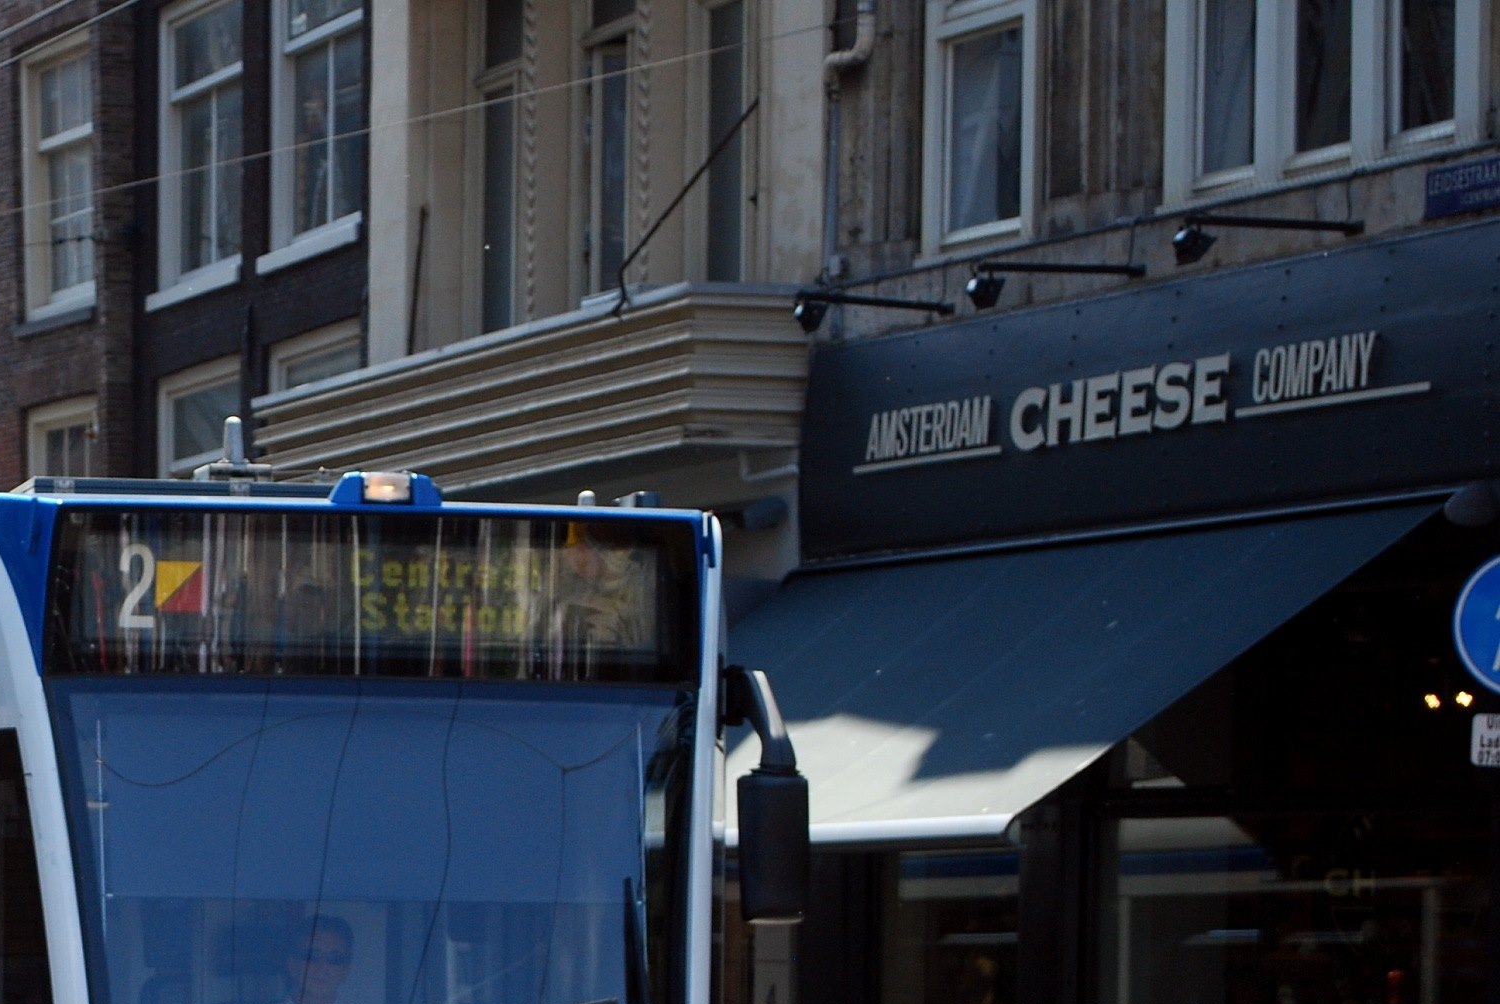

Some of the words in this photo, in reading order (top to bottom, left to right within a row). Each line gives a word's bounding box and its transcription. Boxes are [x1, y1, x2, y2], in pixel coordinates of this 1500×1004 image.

[865, 395, 992, 461] AMSTERDAM
[1010, 352, 1231, 452] CHEESE
[1252, 330, 1377, 404] COMPANY
[118, 544, 155, 629] 2
[351, 548, 541, 591] Centraal
[361, 591, 528, 634] Station
